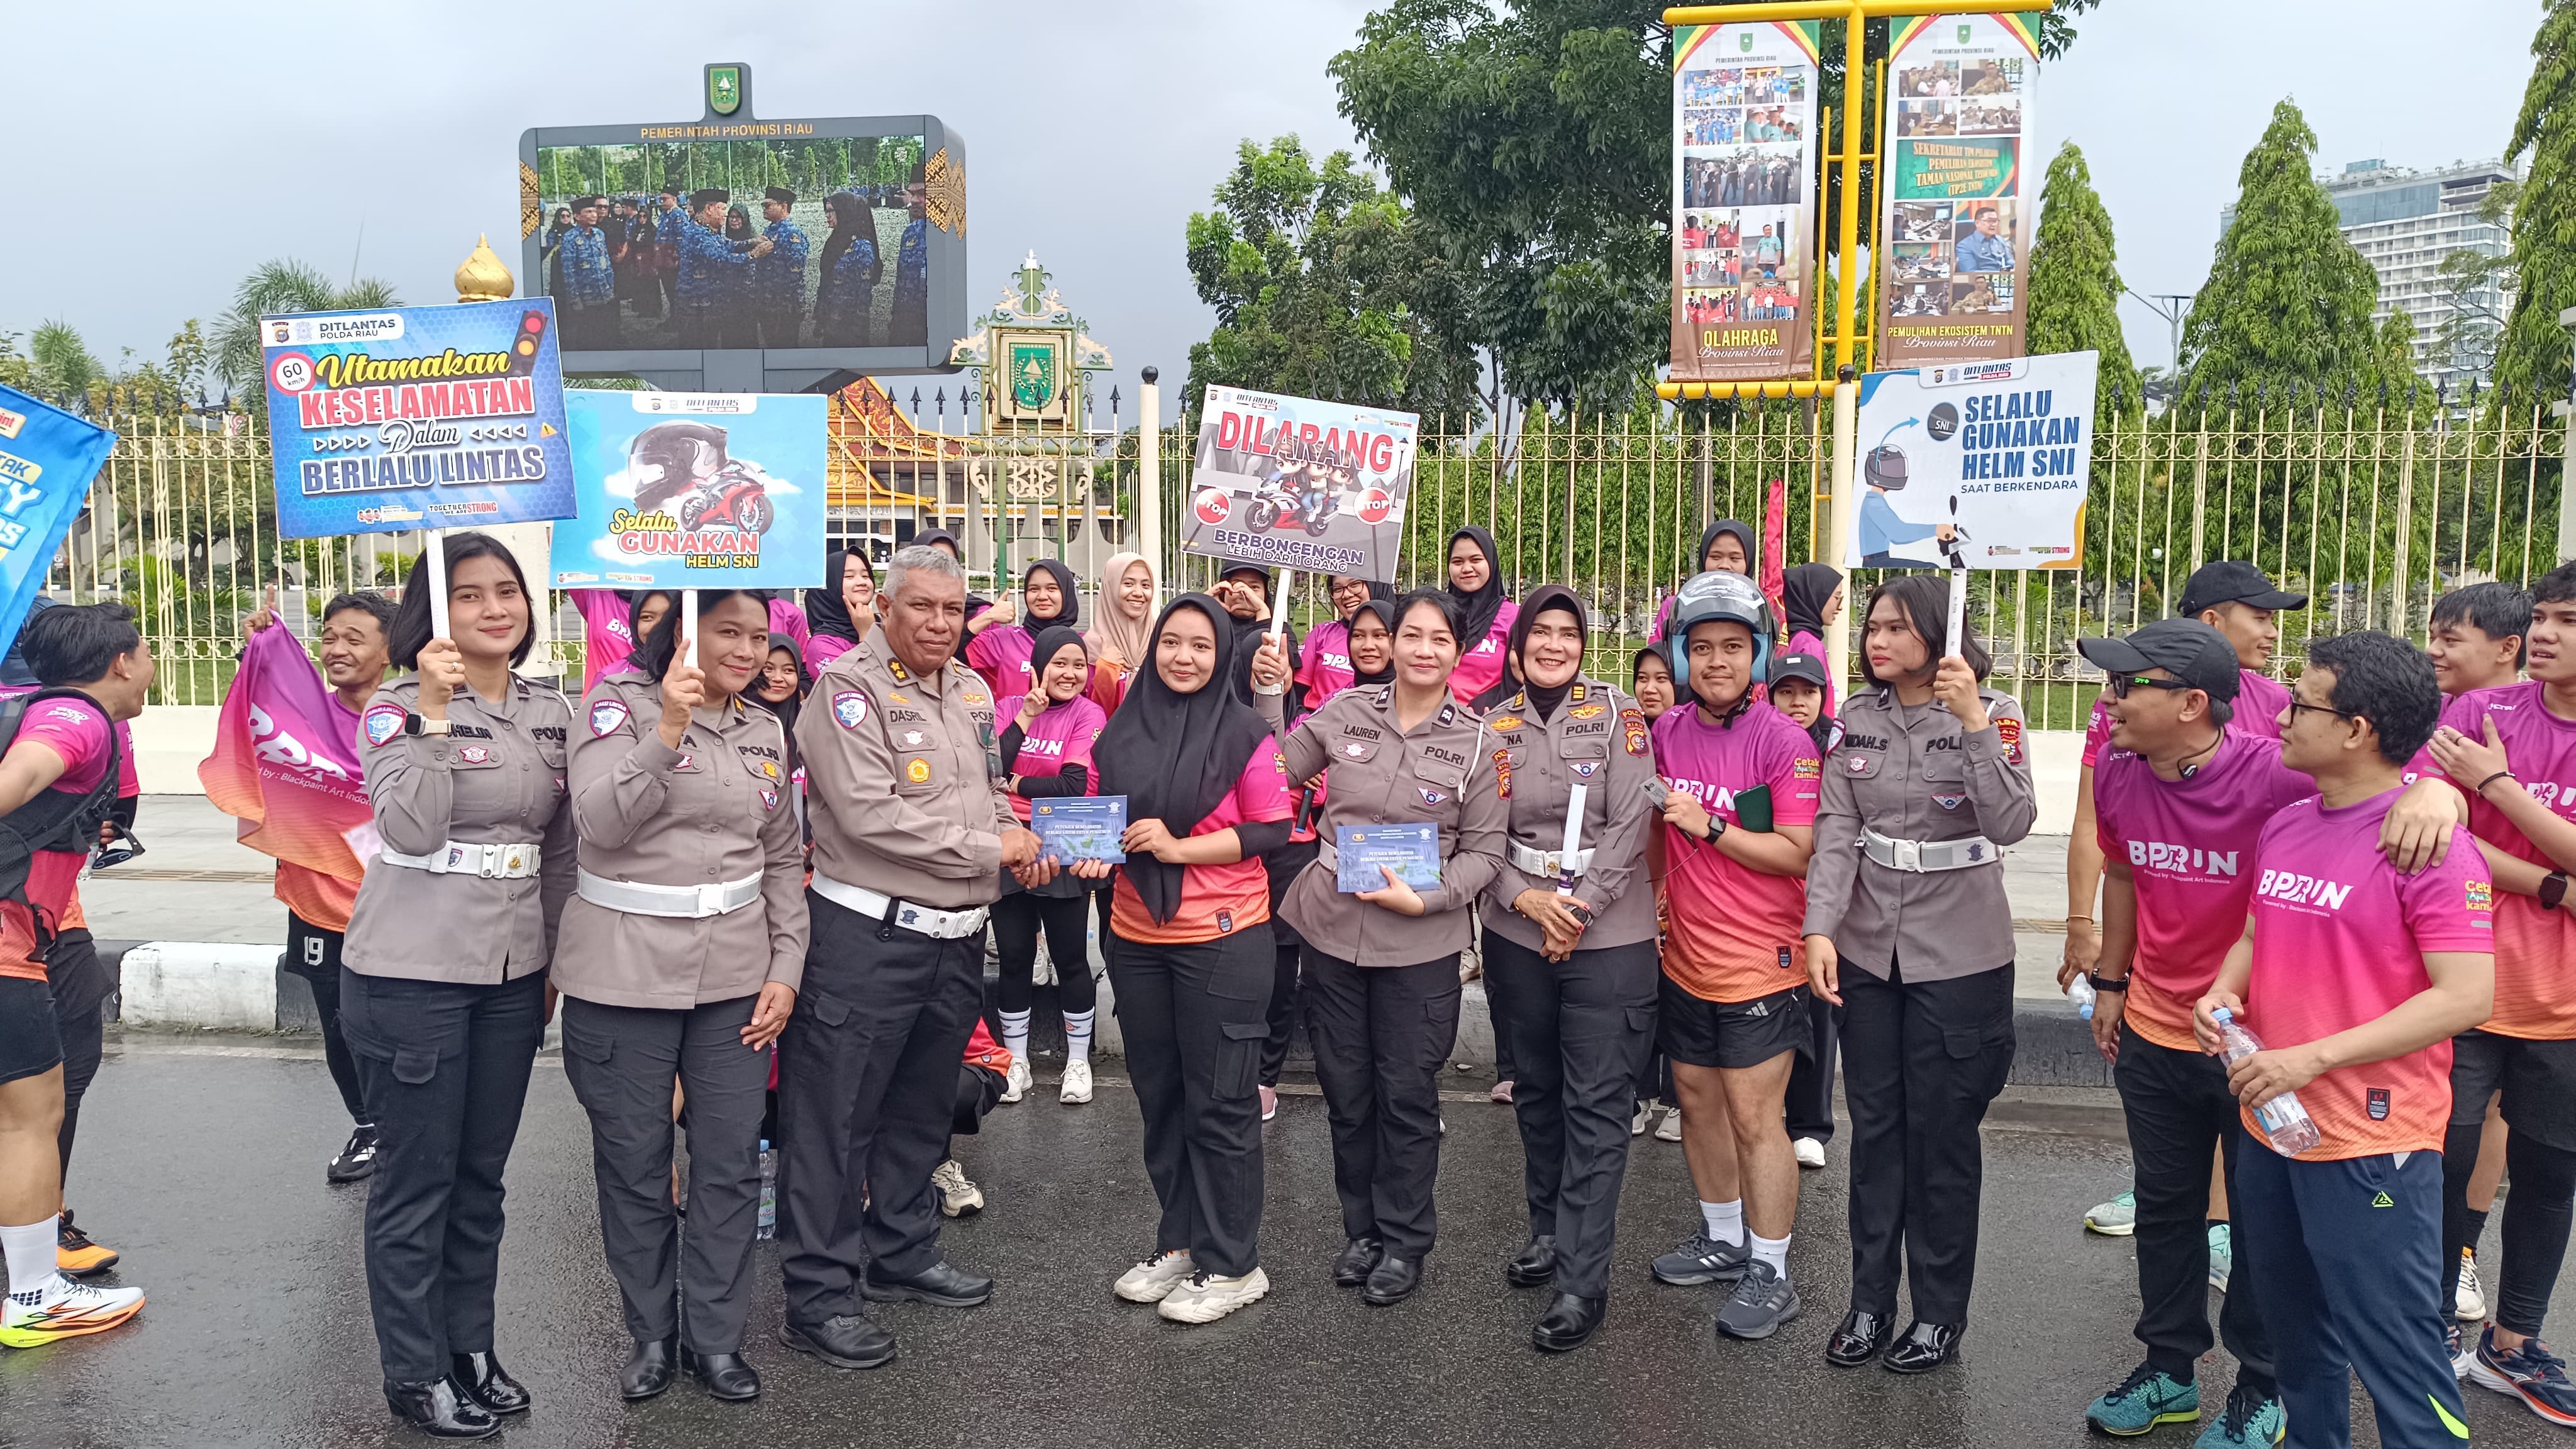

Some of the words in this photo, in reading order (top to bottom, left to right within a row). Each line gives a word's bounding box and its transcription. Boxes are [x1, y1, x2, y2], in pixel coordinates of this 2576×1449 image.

[641, 126, 719, 139] PEMERINTAH
[723, 124, 780, 136] PROVINSI
[784, 124, 813, 135] RIAU
[1916, 172, 1943, 186] TAMAN
[319, 319, 396, 332] DITLANTAS
[1888, 326, 1937, 337] PEMULIHAN
[1939, 325, 1988, 336] EKOSISTEM
[1990, 325, 2013, 335] TNTN
[320, 330, 353, 339] POLDA
[1704, 328, 1779, 347] OLAHRAGA
[1902, 336, 1961, 348] Provinsi
[1962, 335, 1996, 347] Riau
[1697, 346, 1750, 358] Provinsi
[1751, 345, 1785, 357] Riau
[283, 363, 302, 378] 60
[316, 349, 513, 389] Utamakan
[287, 377, 305, 386] km/h
[299, 379, 535, 426] KESELAMATAN
[1965, 390, 2052, 423] SELALU
[1935, 420, 1950, 431] SNI
[1962, 416, 2080, 451] GUNAKAN
[379, 420, 460, 454] Dalam
[1217, 411, 1394, 474] DILARANG
[303, 454, 433, 493] BERLALU
[440, 447, 545, 483] LINTAS
[1962, 451, 2024, 480] HELM
[2032, 448, 2075, 477] SNI
[1961, 484, 1990, 494] SAAT
[1994, 480, 2078, 492] BERKENDARA
[467, 502, 496, 513] STRONG
[609, 508, 678, 533] Selalu
[618, 531, 760, 555] GUNAKAN
[1214, 529, 1365, 565] BERBONCENGAN
[686, 554, 729, 569] HELM
[733, 554, 758, 568] SNI
[1226, 544, 1262, 559] LEBIH
[1265, 551, 1294, 564] DARI
[1296, 555, 1301, 565] 1
[1303, 557, 1348, 573] ORANG
[890, 710, 927, 723] DASRIL
[1344, 724, 1381, 740] LAUREN
[1566, 723, 1604, 735] POLRI
[1425, 746, 1466, 765] POLRI
[1794, 757, 1819, 767] Cetak
[262, 768, 274, 779] by
[280, 773, 328, 792] Blackpaint
[330, 786, 345, 797] Art
[304, 936, 325, 966] 19
